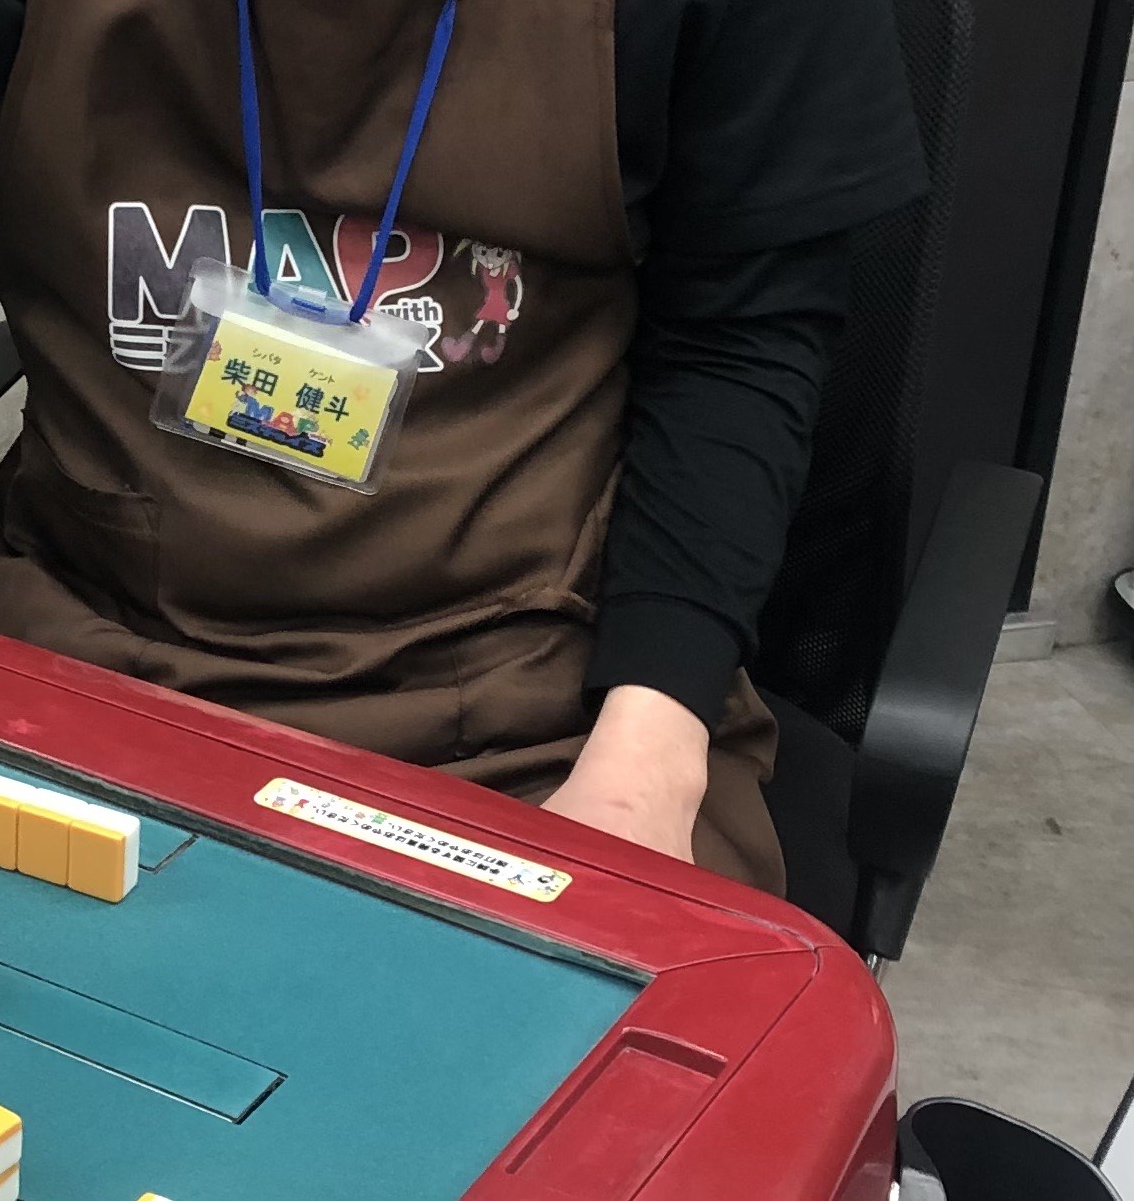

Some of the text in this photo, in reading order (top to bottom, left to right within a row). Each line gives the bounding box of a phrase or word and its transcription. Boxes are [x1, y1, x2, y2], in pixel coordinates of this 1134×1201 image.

[108, 202, 445, 325] MAP
[221, 358, 350, 422] 柴田 健斗
